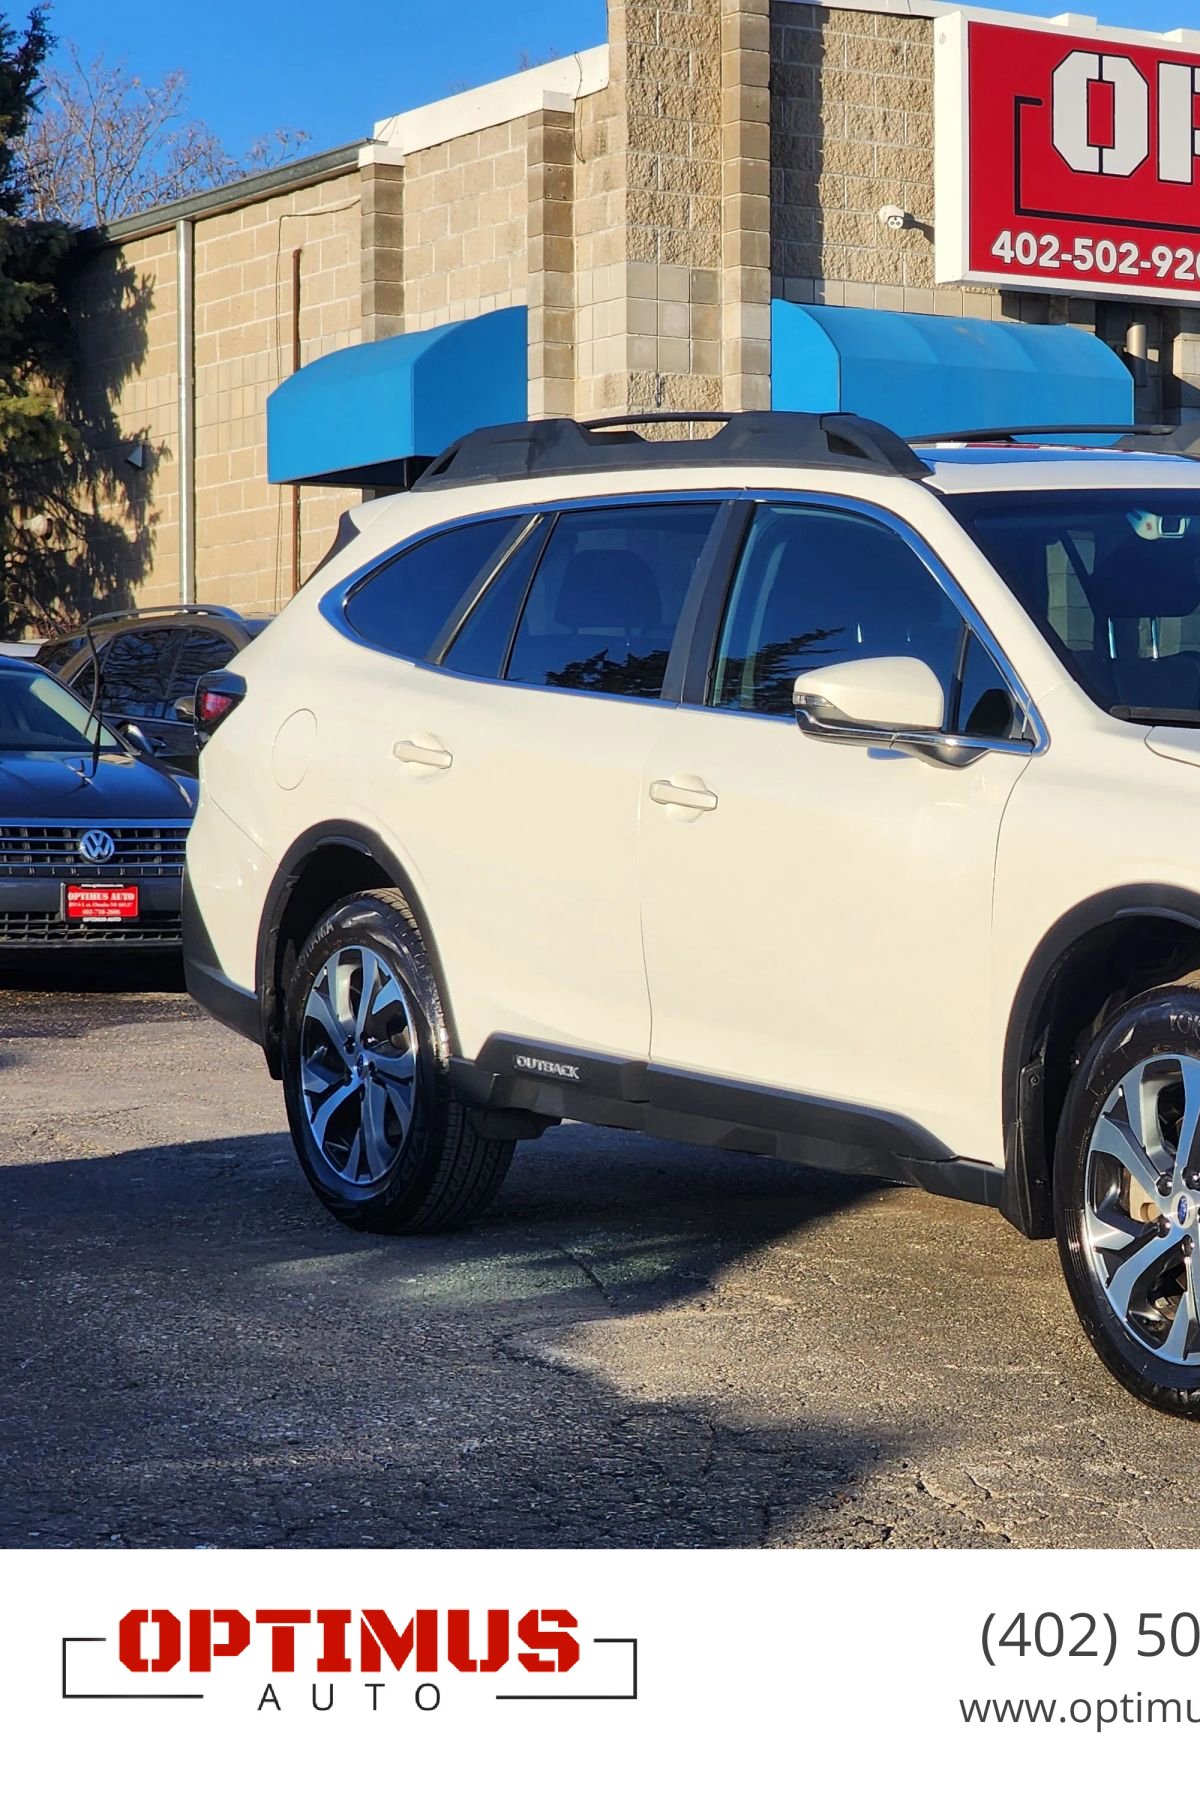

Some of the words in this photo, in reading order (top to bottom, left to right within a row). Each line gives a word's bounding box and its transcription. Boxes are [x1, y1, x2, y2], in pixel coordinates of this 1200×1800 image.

[68, 892, 108, 901] OPTIMUS
[110, 892, 135, 901] AUTO
[516, 1055, 580, 1080] OUTBACK
